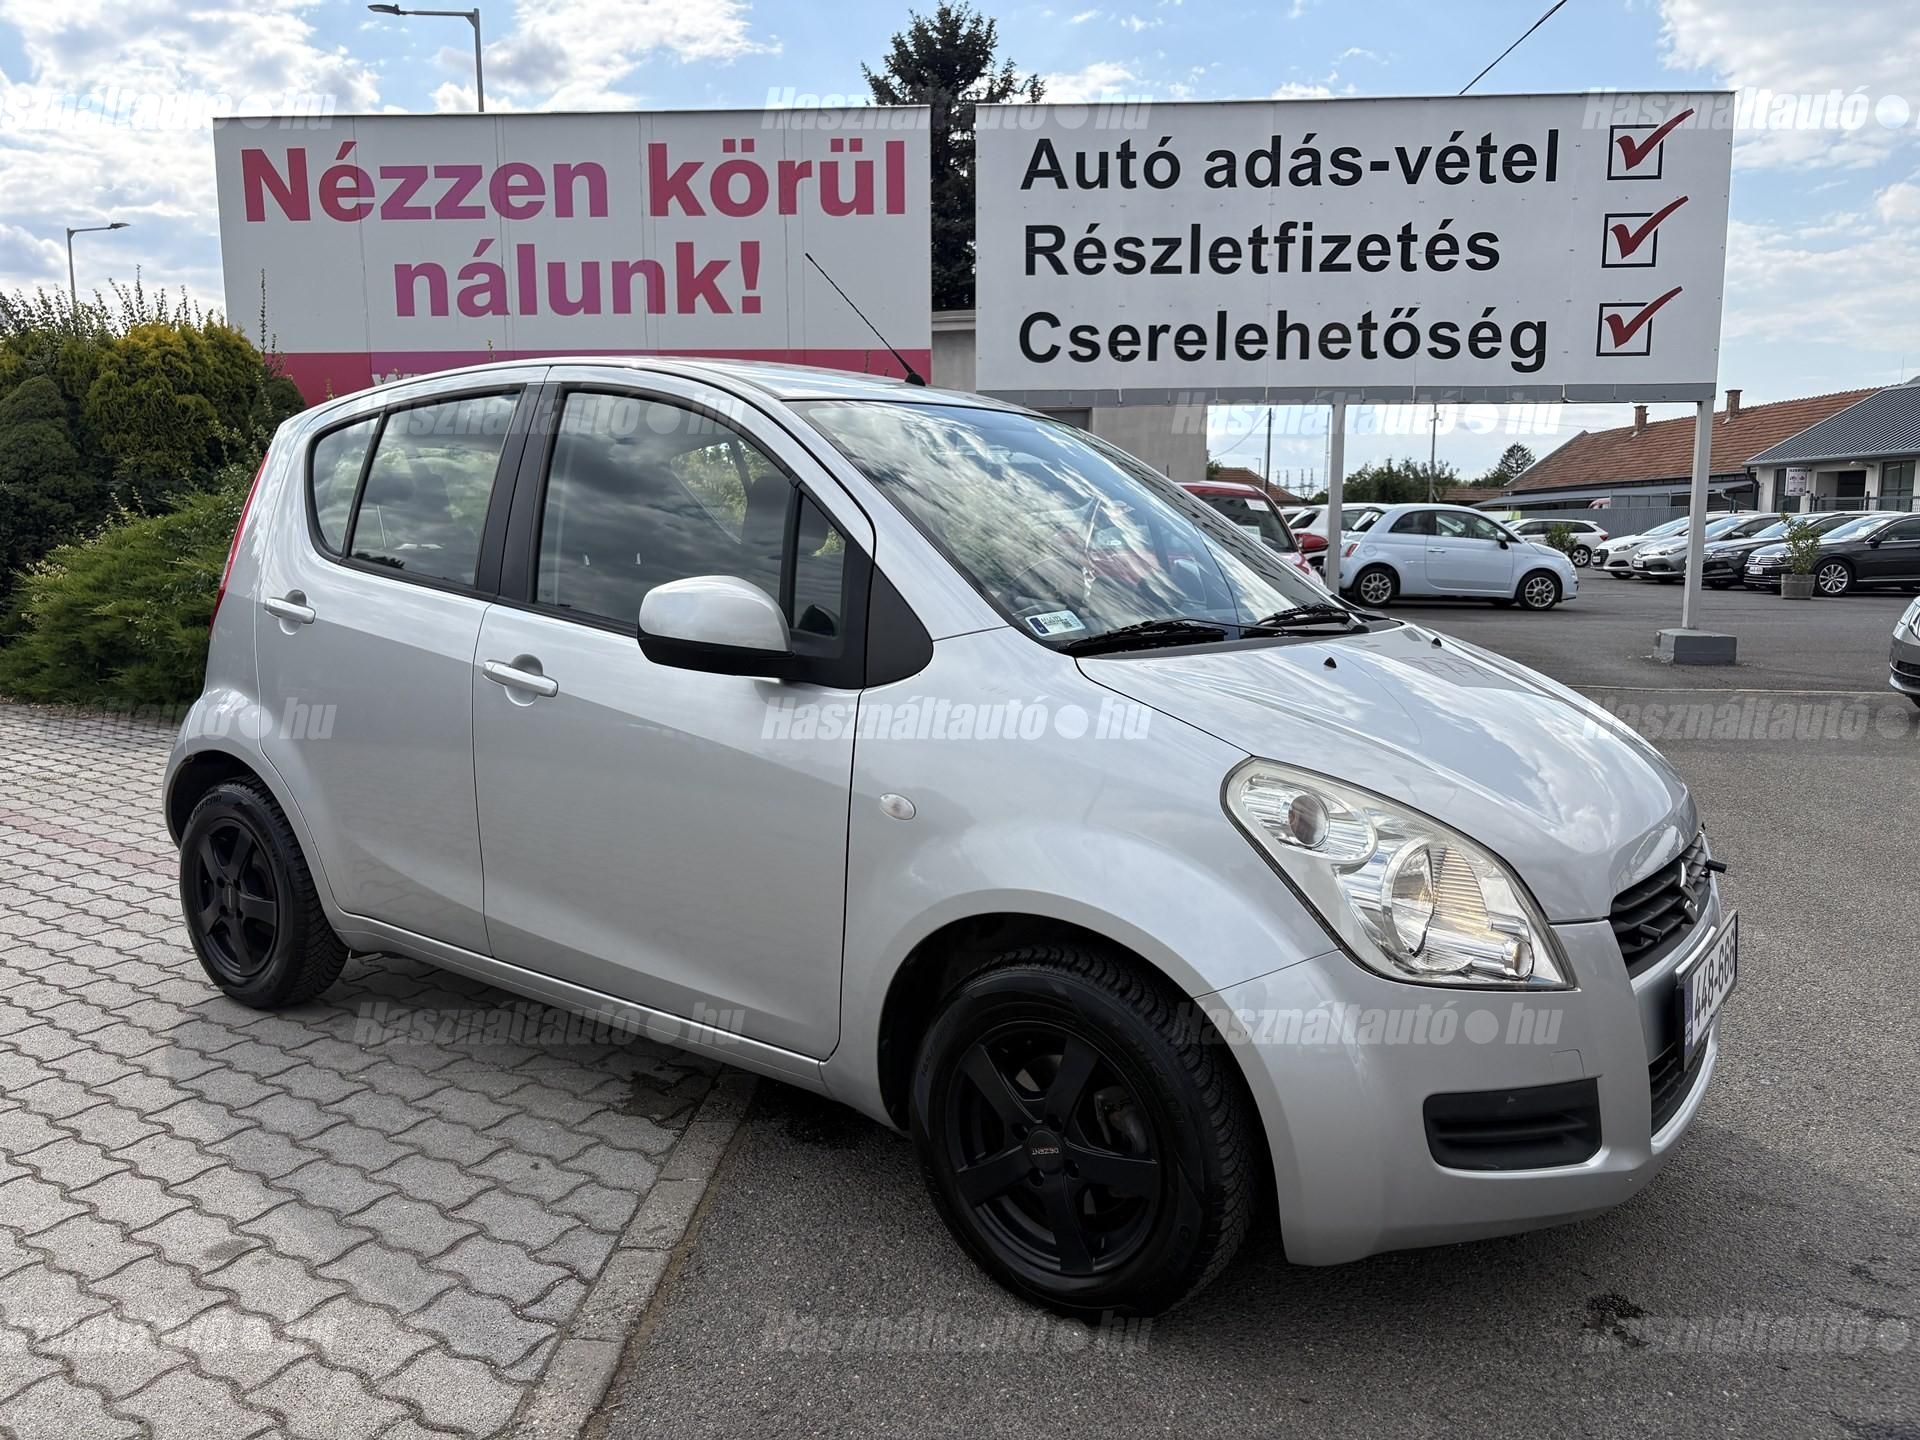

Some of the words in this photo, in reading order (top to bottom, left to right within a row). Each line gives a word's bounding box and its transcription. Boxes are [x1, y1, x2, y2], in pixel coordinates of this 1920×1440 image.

[241, 141, 608, 222] Nézzen
[649, 138, 905, 217] körül
[1020, 135, 1181, 190] Autó
[1204, 129, 1559, 189] adás-vétel
[395, 239, 761, 316] nálunk!
[1025, 218, 1500, 276] Részletfizetés
[1019, 306, 1547, 374] Cserelehetőség
